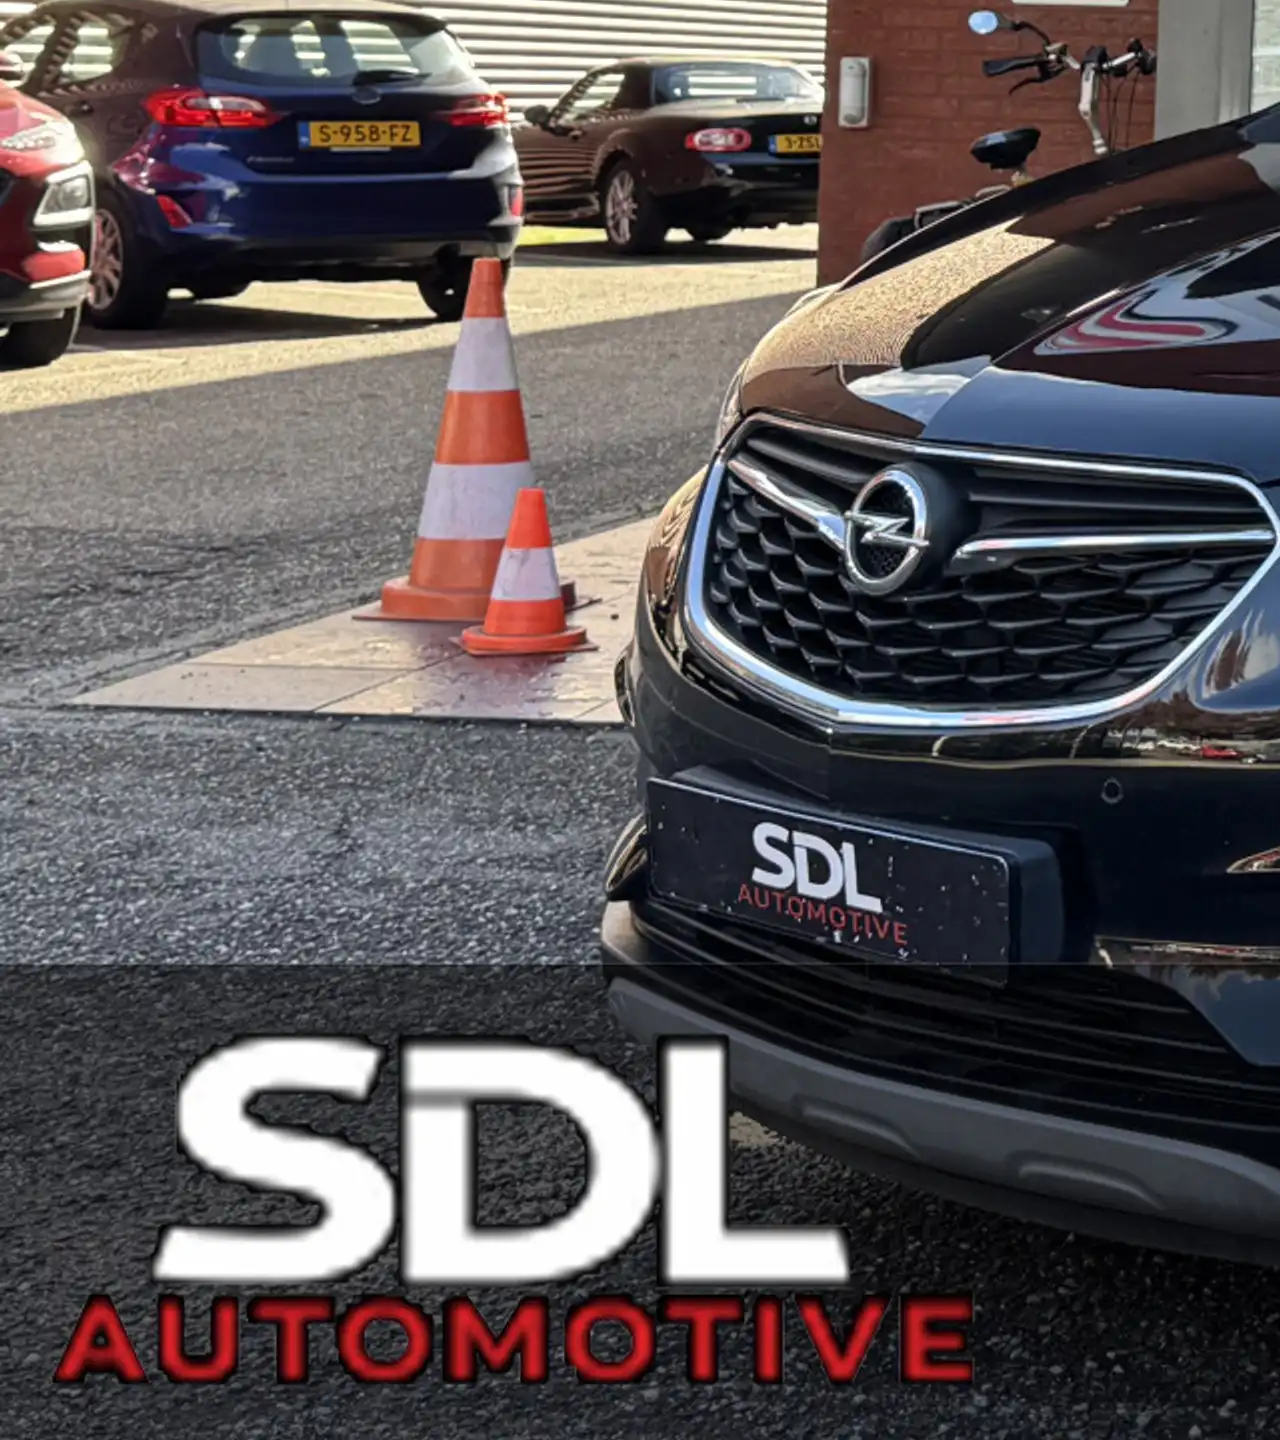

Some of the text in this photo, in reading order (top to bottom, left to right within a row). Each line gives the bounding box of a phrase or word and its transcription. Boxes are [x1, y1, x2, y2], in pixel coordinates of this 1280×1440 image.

[319, 123, 414, 144] S-958-FZ
[750, 821, 884, 913] SDL
[737, 882, 909, 947] AUTOMOTIVE
